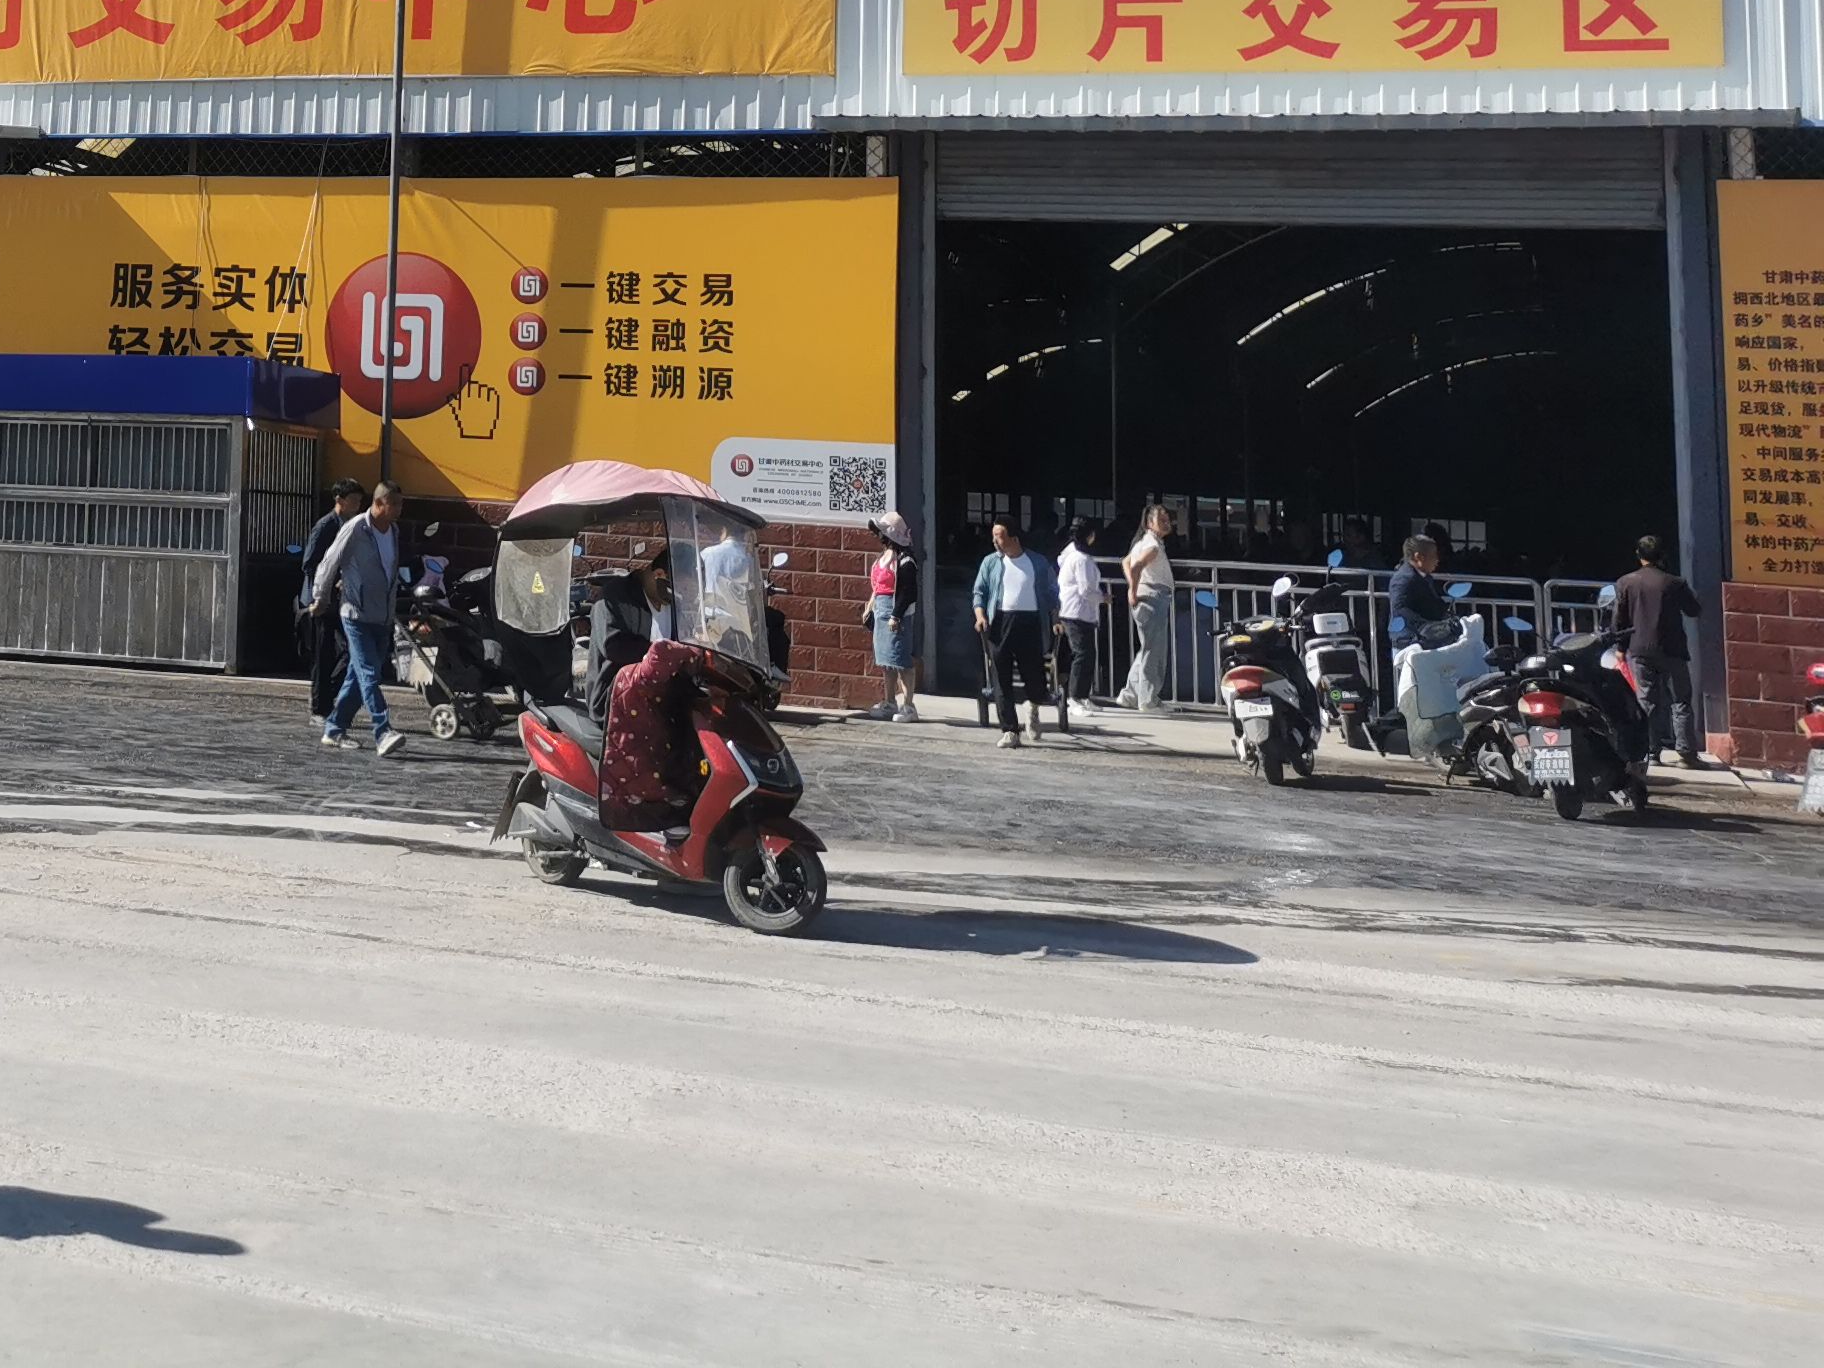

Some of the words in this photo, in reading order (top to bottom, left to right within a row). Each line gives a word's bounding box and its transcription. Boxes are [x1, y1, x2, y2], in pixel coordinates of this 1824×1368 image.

[109, 263, 309, 315] 服务实体
[560, 270, 734, 307] 一键交易
[558, 316, 734, 354] 一键融资
[558, 362, 734, 401] 一键溯源
[1740, 446, 1824, 462] 、中间服务
[1741, 468, 1824, 484] 交易成本高
